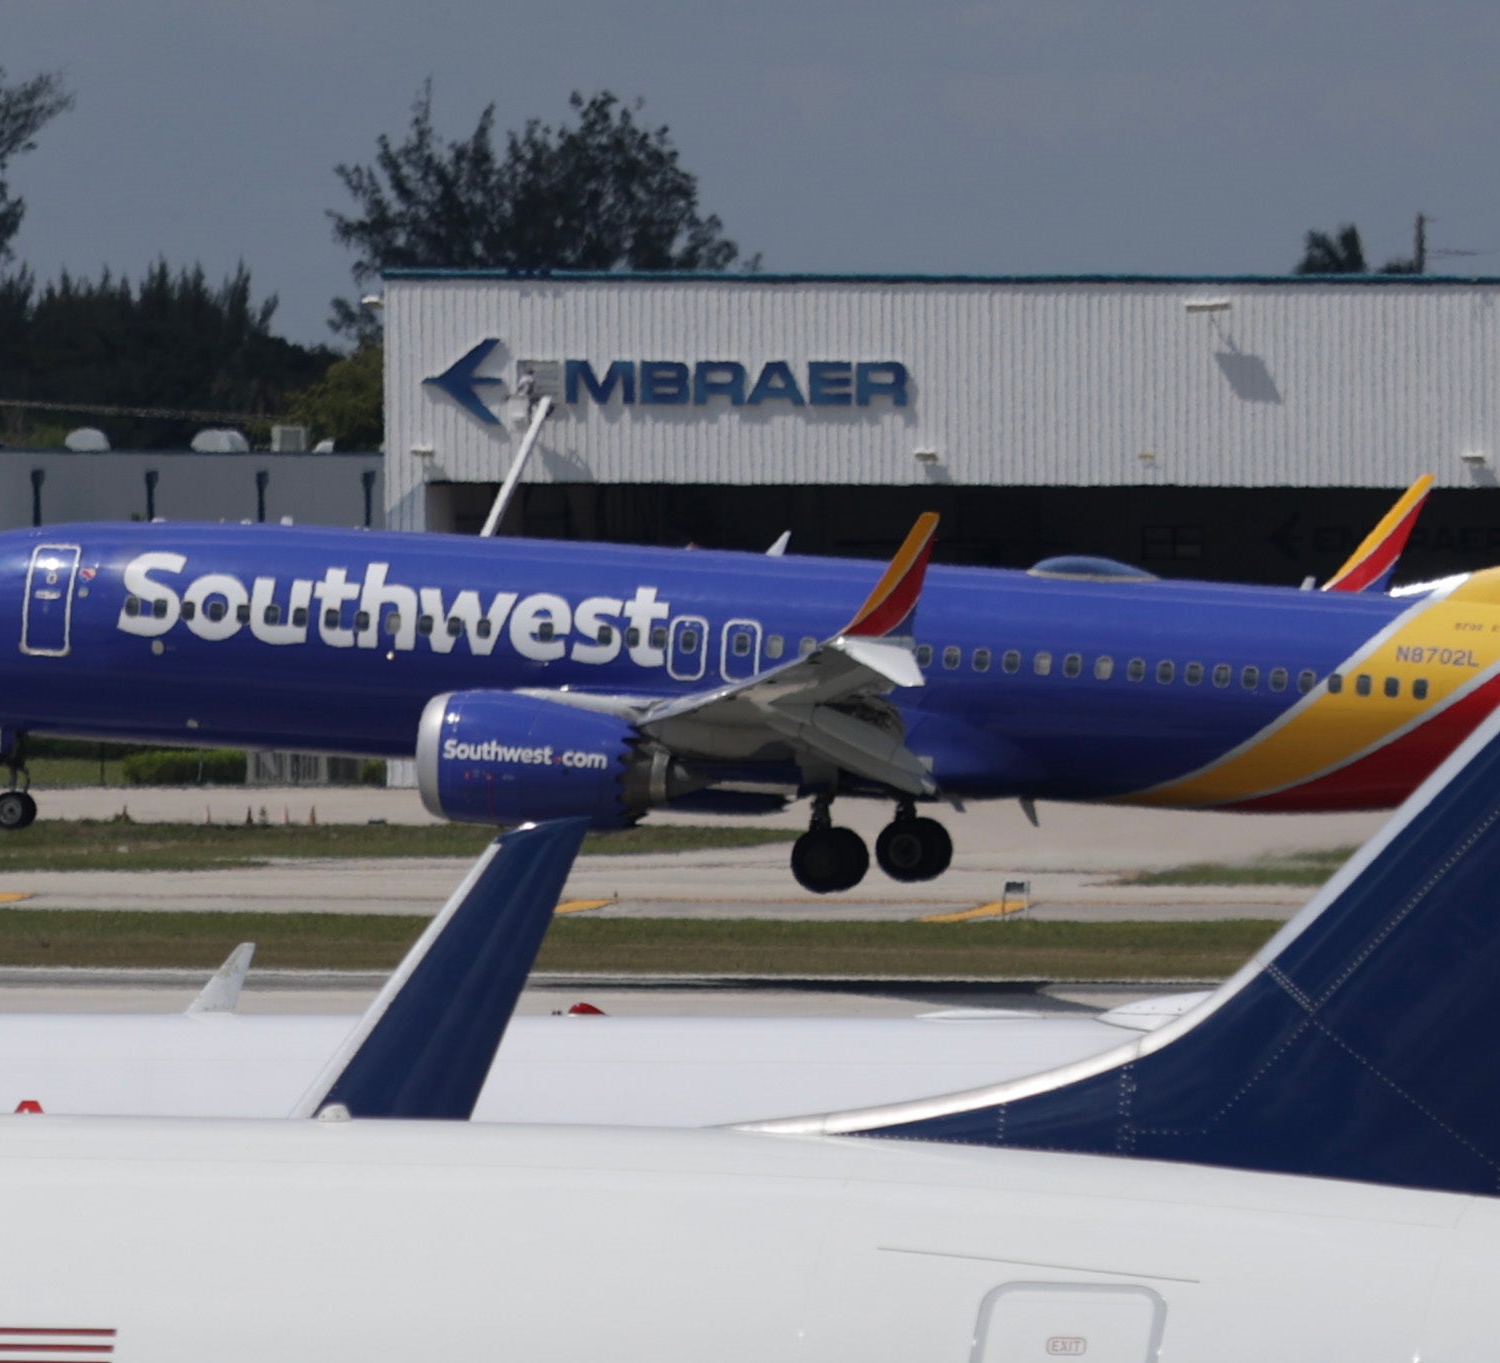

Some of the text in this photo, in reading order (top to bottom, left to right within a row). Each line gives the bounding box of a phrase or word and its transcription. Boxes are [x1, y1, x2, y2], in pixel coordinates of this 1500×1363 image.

[116, 551, 670, 669] Southwest
[1395, 646, 1480, 667] N8702L
[1051, 1340, 1081, 1352] EXIT
